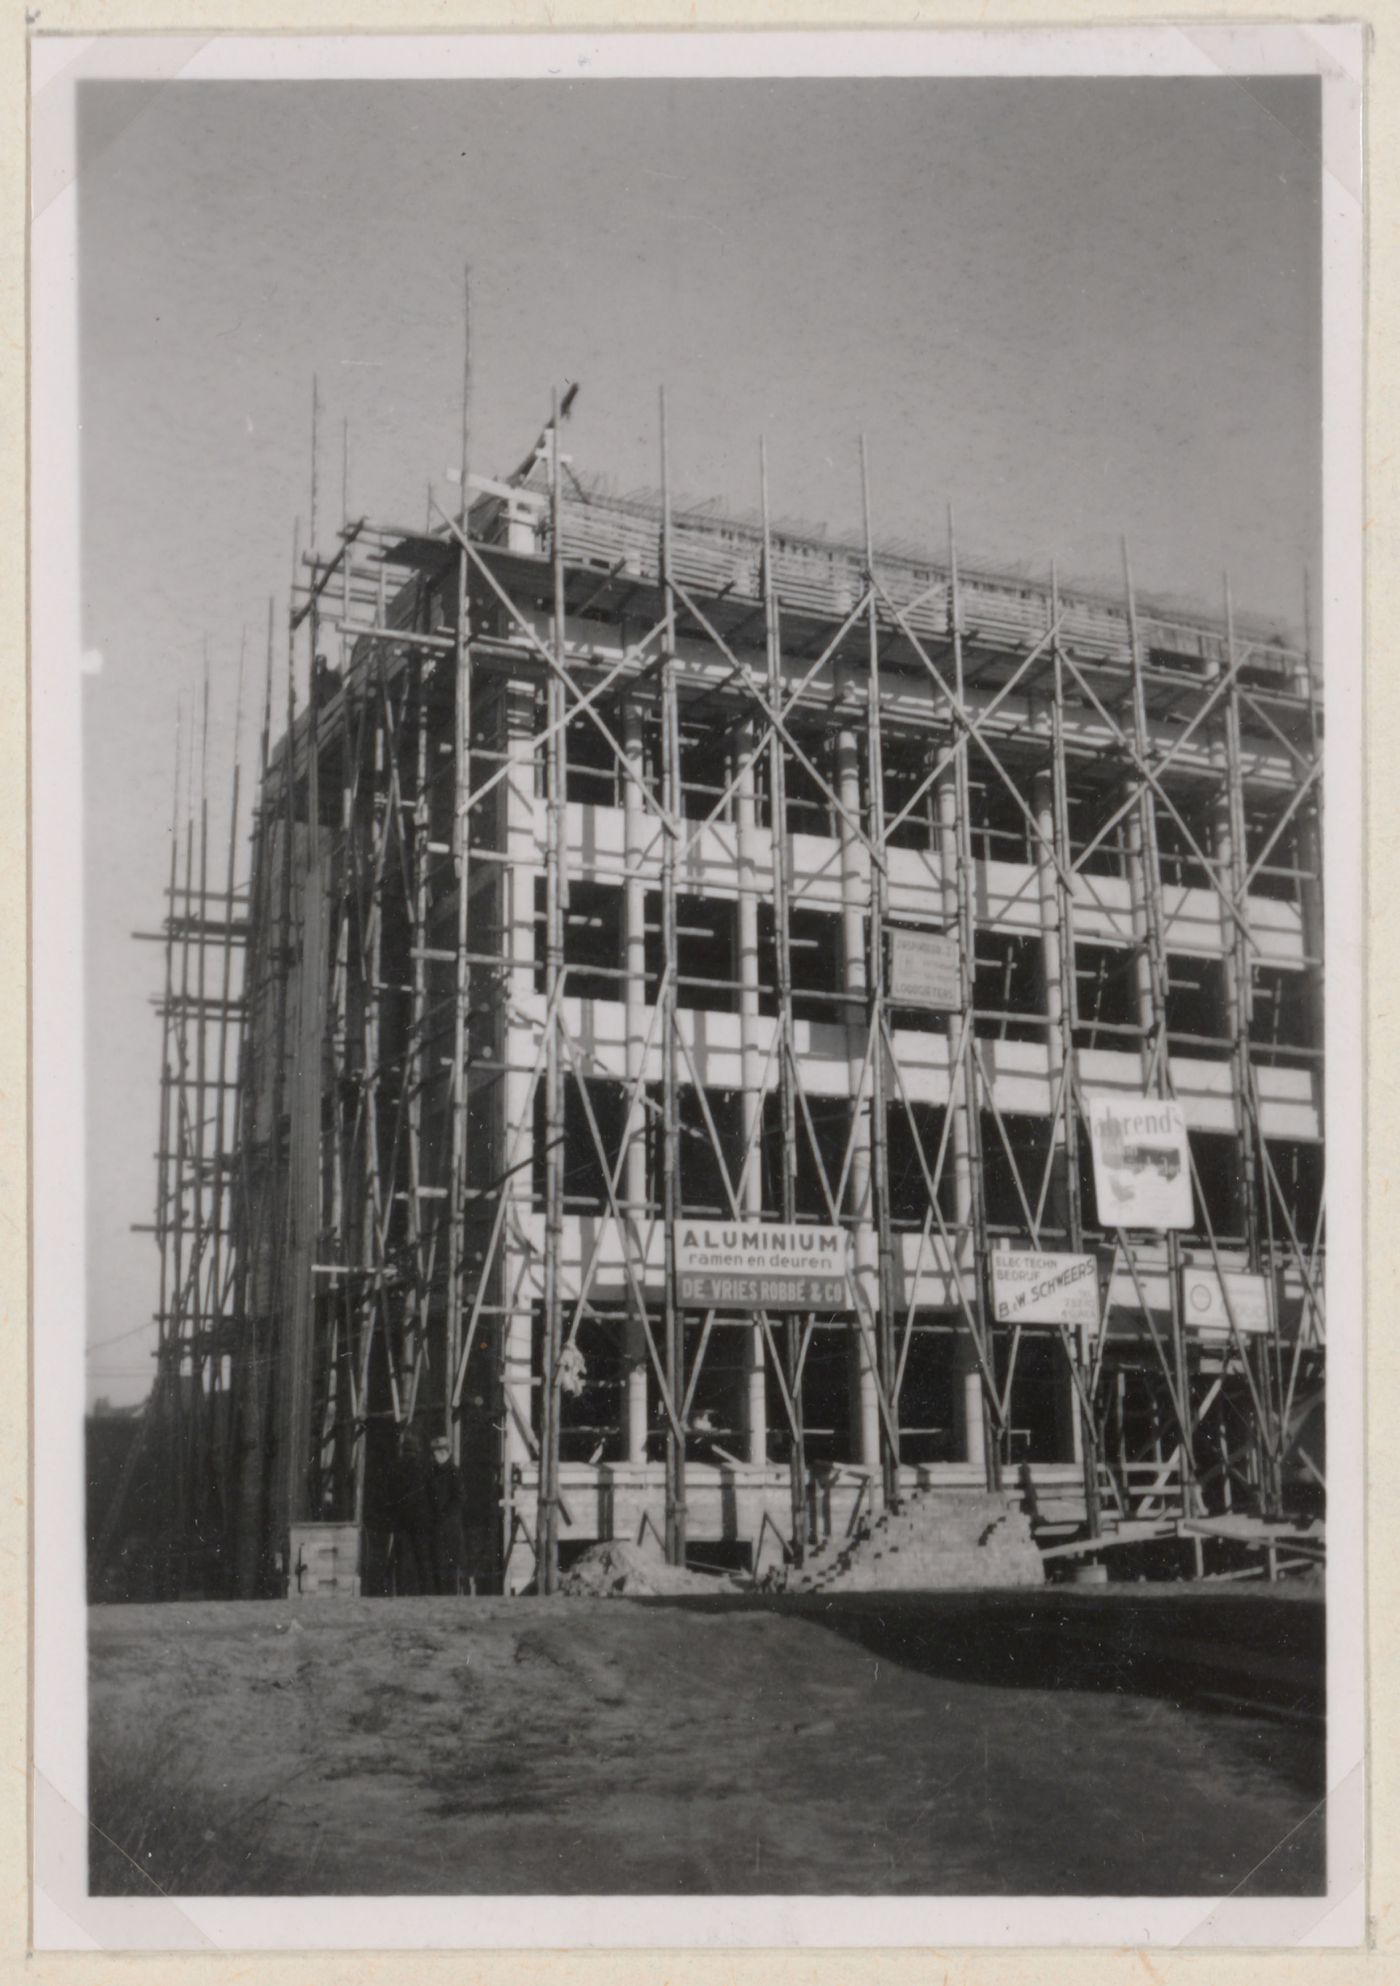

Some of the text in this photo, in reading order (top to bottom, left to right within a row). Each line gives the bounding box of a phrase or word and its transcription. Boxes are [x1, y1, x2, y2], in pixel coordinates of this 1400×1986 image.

[683, 1229, 838, 1252] ALUMINIUM
[688, 1252, 832, 1269] ramen en deuren
[682, 1278, 704, 1299] DE
[711, 1279, 758, 1300] VRIES
[1030, 1258, 1096, 1303] SCHWEERS
